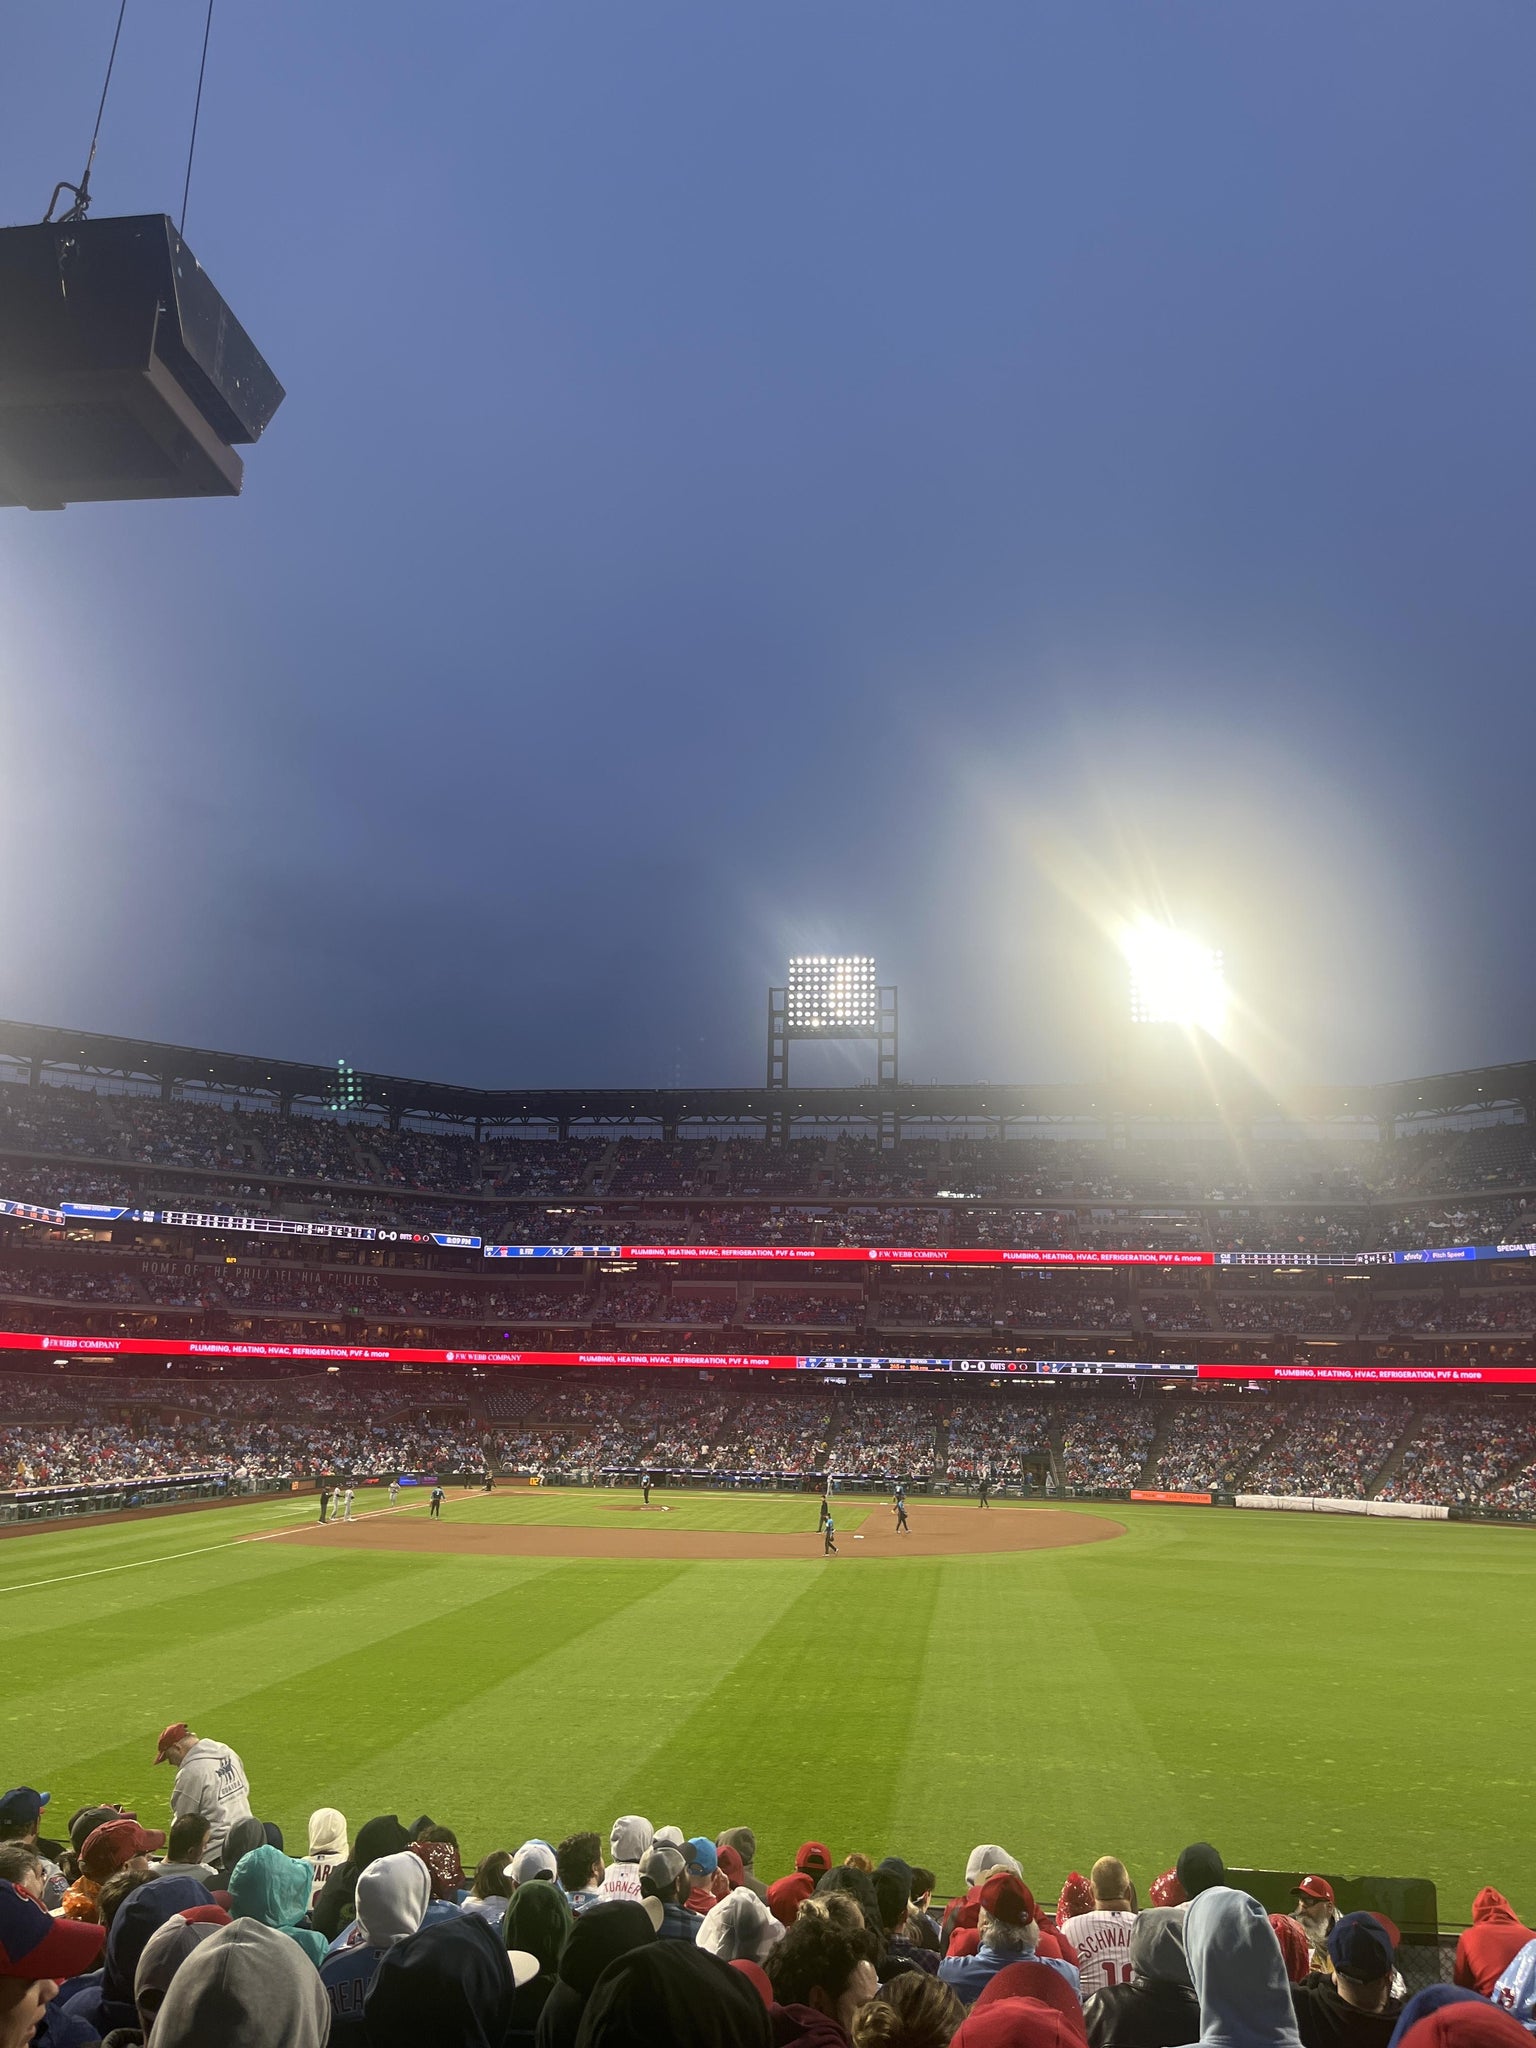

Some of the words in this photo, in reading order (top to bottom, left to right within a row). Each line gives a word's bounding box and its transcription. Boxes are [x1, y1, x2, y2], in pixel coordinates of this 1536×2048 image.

[378, 1231, 397, 1240] 0-0
[1404, 1253, 1422, 1261] xfinity
[142, 1261, 177, 1273] HOME
[184, 1264, 199, 1275] OF
[207, 1265, 228, 1277] HE
[190, 1344, 231, 1352] PLUMBING,
[233, 1346, 266, 1354] HEATING,
[293, 1348, 348, 1357] REFRIGERATION,
[1275, 1369, 1316, 1377] PLUMBING,
[314, 1865, 330, 1881] AR
[604, 1881, 641, 1896] TURNER
[327, 1978, 367, 2015] REA
